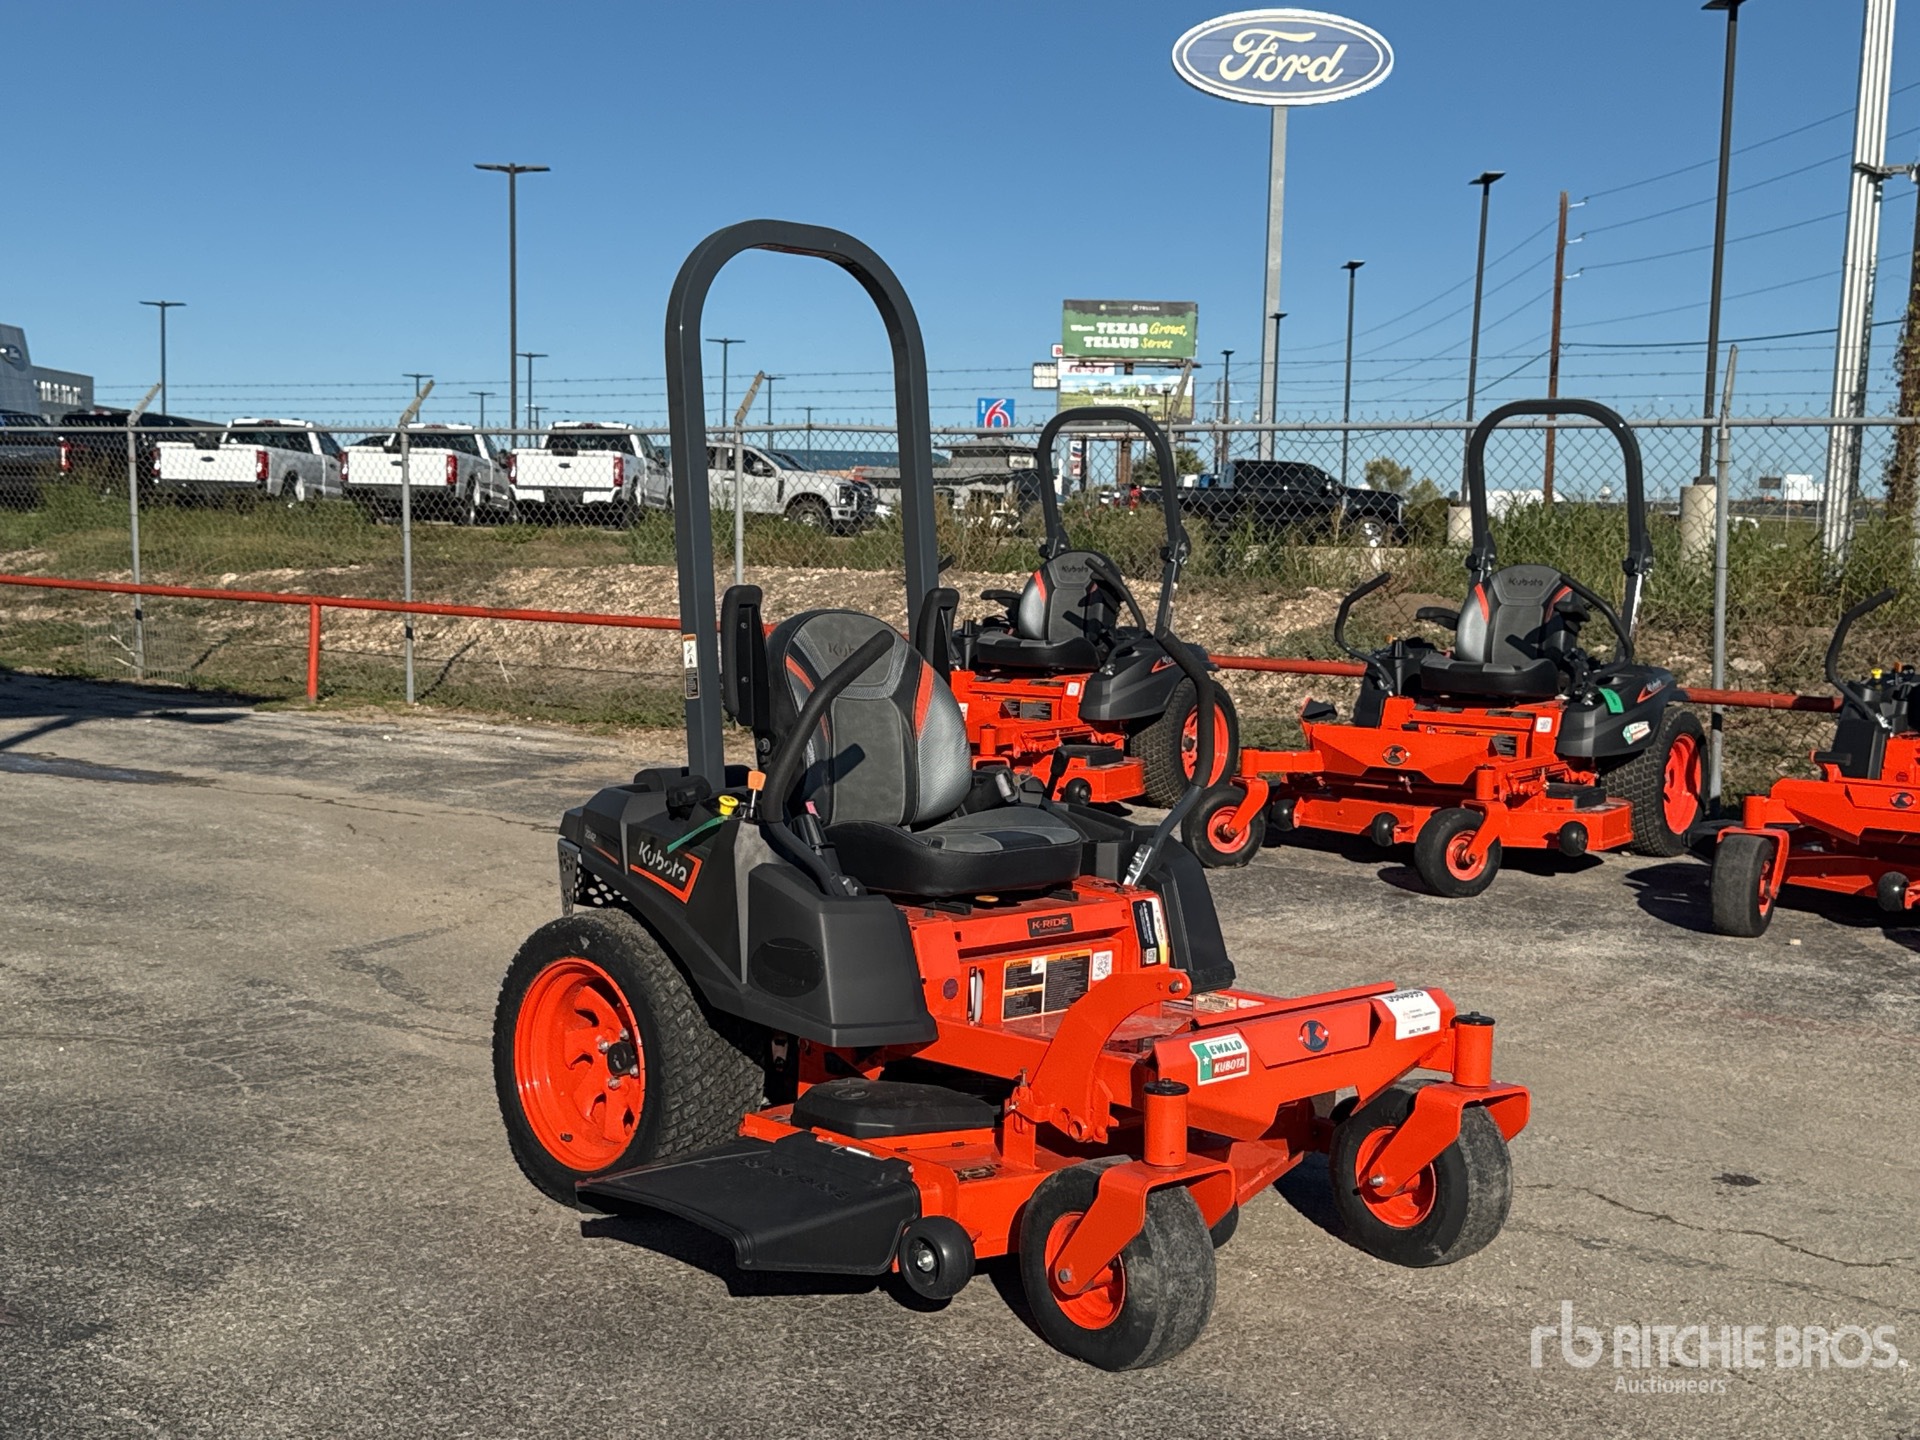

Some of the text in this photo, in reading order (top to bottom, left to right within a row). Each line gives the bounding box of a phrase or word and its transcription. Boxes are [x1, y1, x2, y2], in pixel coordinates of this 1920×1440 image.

[1219, 28, 1348, 83] Ford
[1096, 322, 1148, 335] TEXAS
[1083, 336, 1139, 348] TELLUS
[984, 399, 1010, 428] 6
[1509, 577, 1543, 586] Kubota
[638, 841, 687, 882] Kubota
[1032, 917, 1069, 930] K-RIDE
[1209, 1040, 1243, 1055] EWALD
[1214, 1057, 1246, 1073] KUBOTA
